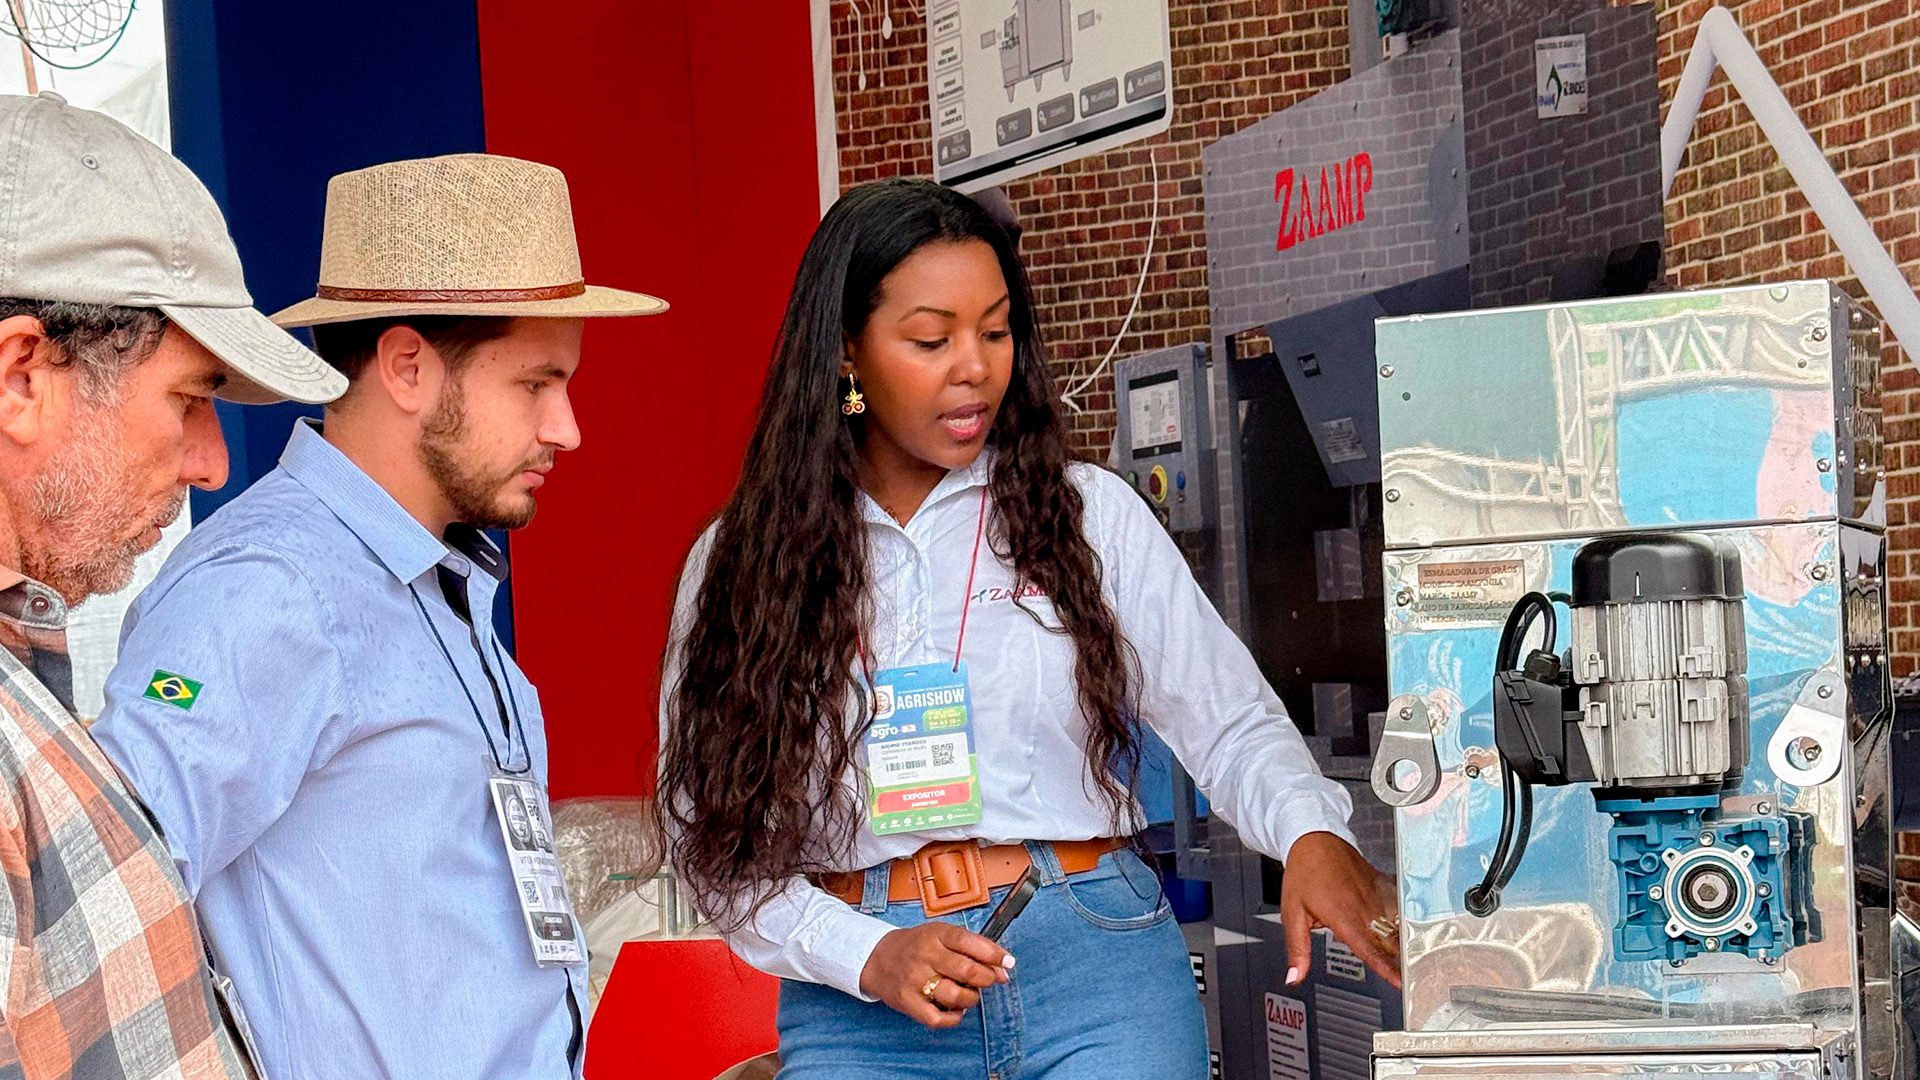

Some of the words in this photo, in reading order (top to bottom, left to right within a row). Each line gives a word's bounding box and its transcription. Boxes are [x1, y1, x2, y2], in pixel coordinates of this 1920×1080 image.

[1275, 152, 1373, 251] ZAAMP
[1423, 567, 1478, 578] ESMAGADORA
[1480, 566, 1491, 575] DE
[1491, 564, 1518, 575] GRÃOS
[989, 585, 1049, 601] ZAAM
[1451, 590, 1478, 599] ZAAMP
[1439, 603, 1449, 611] DE
[896, 688, 965, 710] AGRISHOW
[871, 726, 898, 739] agro
[902, 789, 945, 801] EXPOSITOR
[1267, 997, 1304, 1031] ZAAMP
